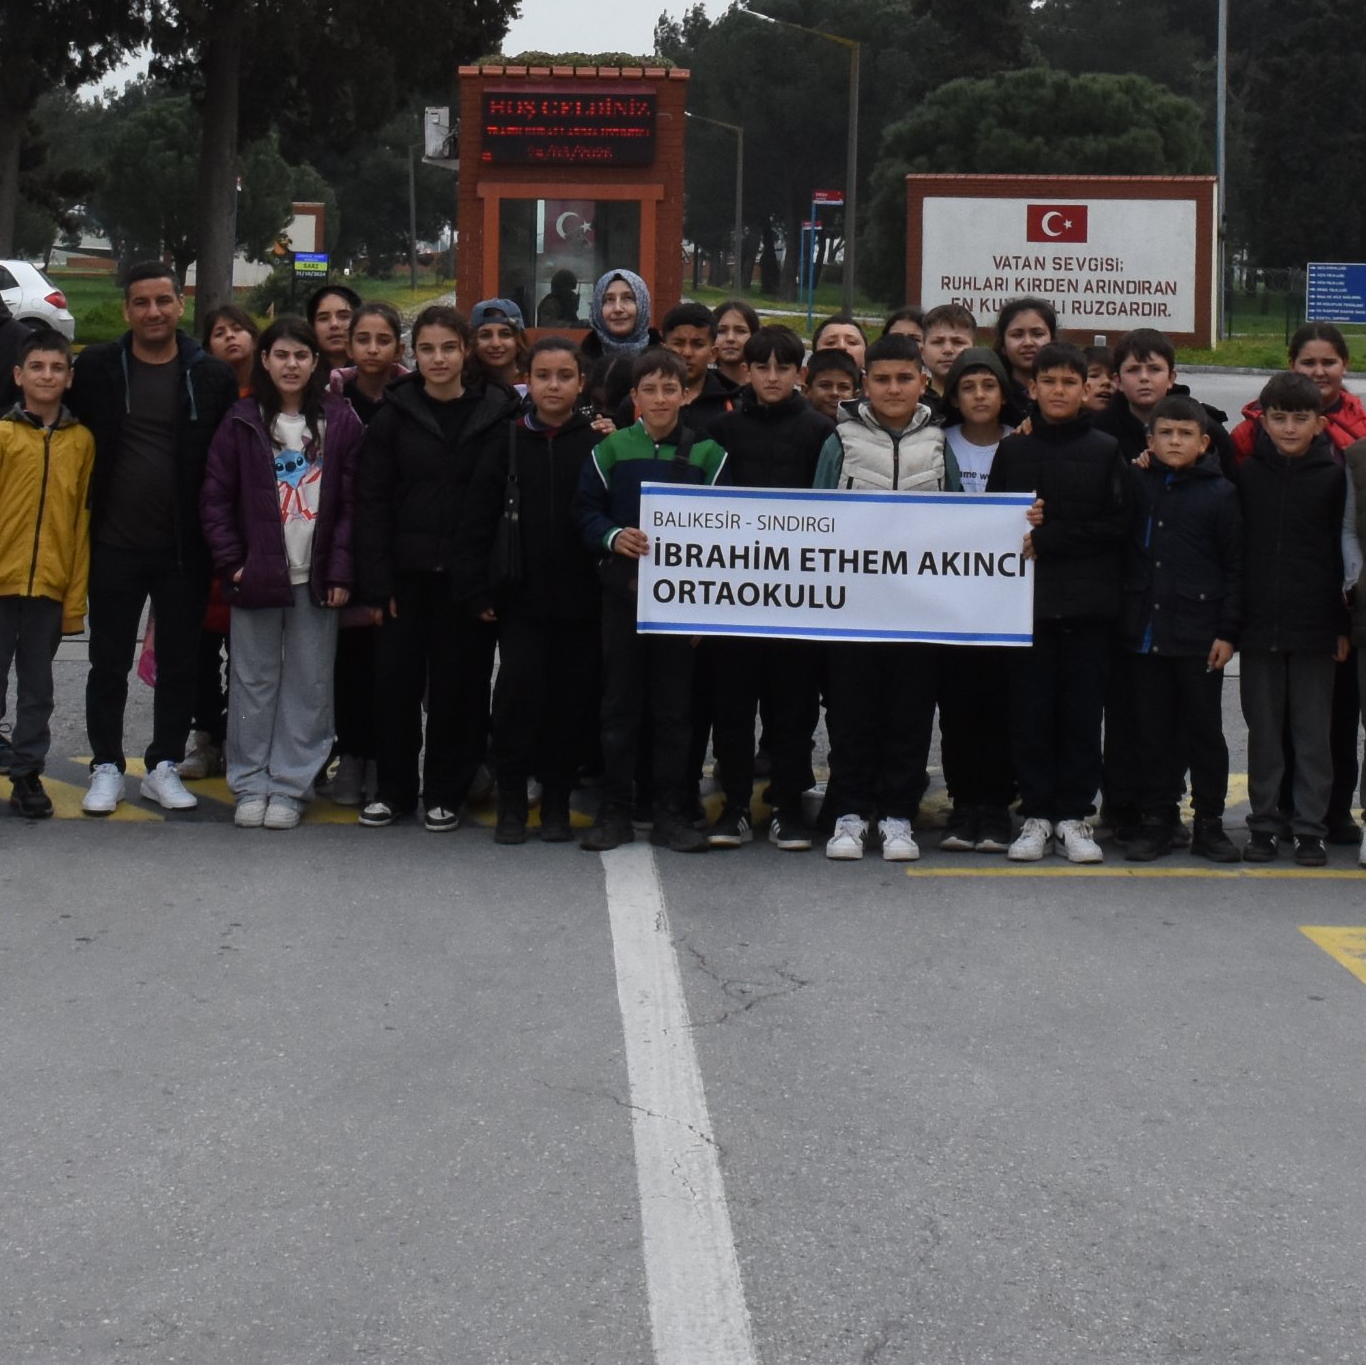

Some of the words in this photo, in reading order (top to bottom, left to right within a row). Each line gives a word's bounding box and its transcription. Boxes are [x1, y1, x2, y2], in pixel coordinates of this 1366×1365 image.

[993, 255, 1046, 271] VATAN
[941, 275, 1009, 292] RUHLARI
[1084, 279, 1177, 296] ARINDIRAN
[1072, 300, 1172, 318] RUZGARDIR.
[653, 510, 741, 530] BALIKESİR
[757, 514, 835, 533] SINDIRGI
[654, 537, 790, 571] İBRAHİM
[800, 548, 908, 576] ETHEM
[917, 551, 1027, 578] AKINCI
[652, 579, 847, 610] ORTAOKULU
